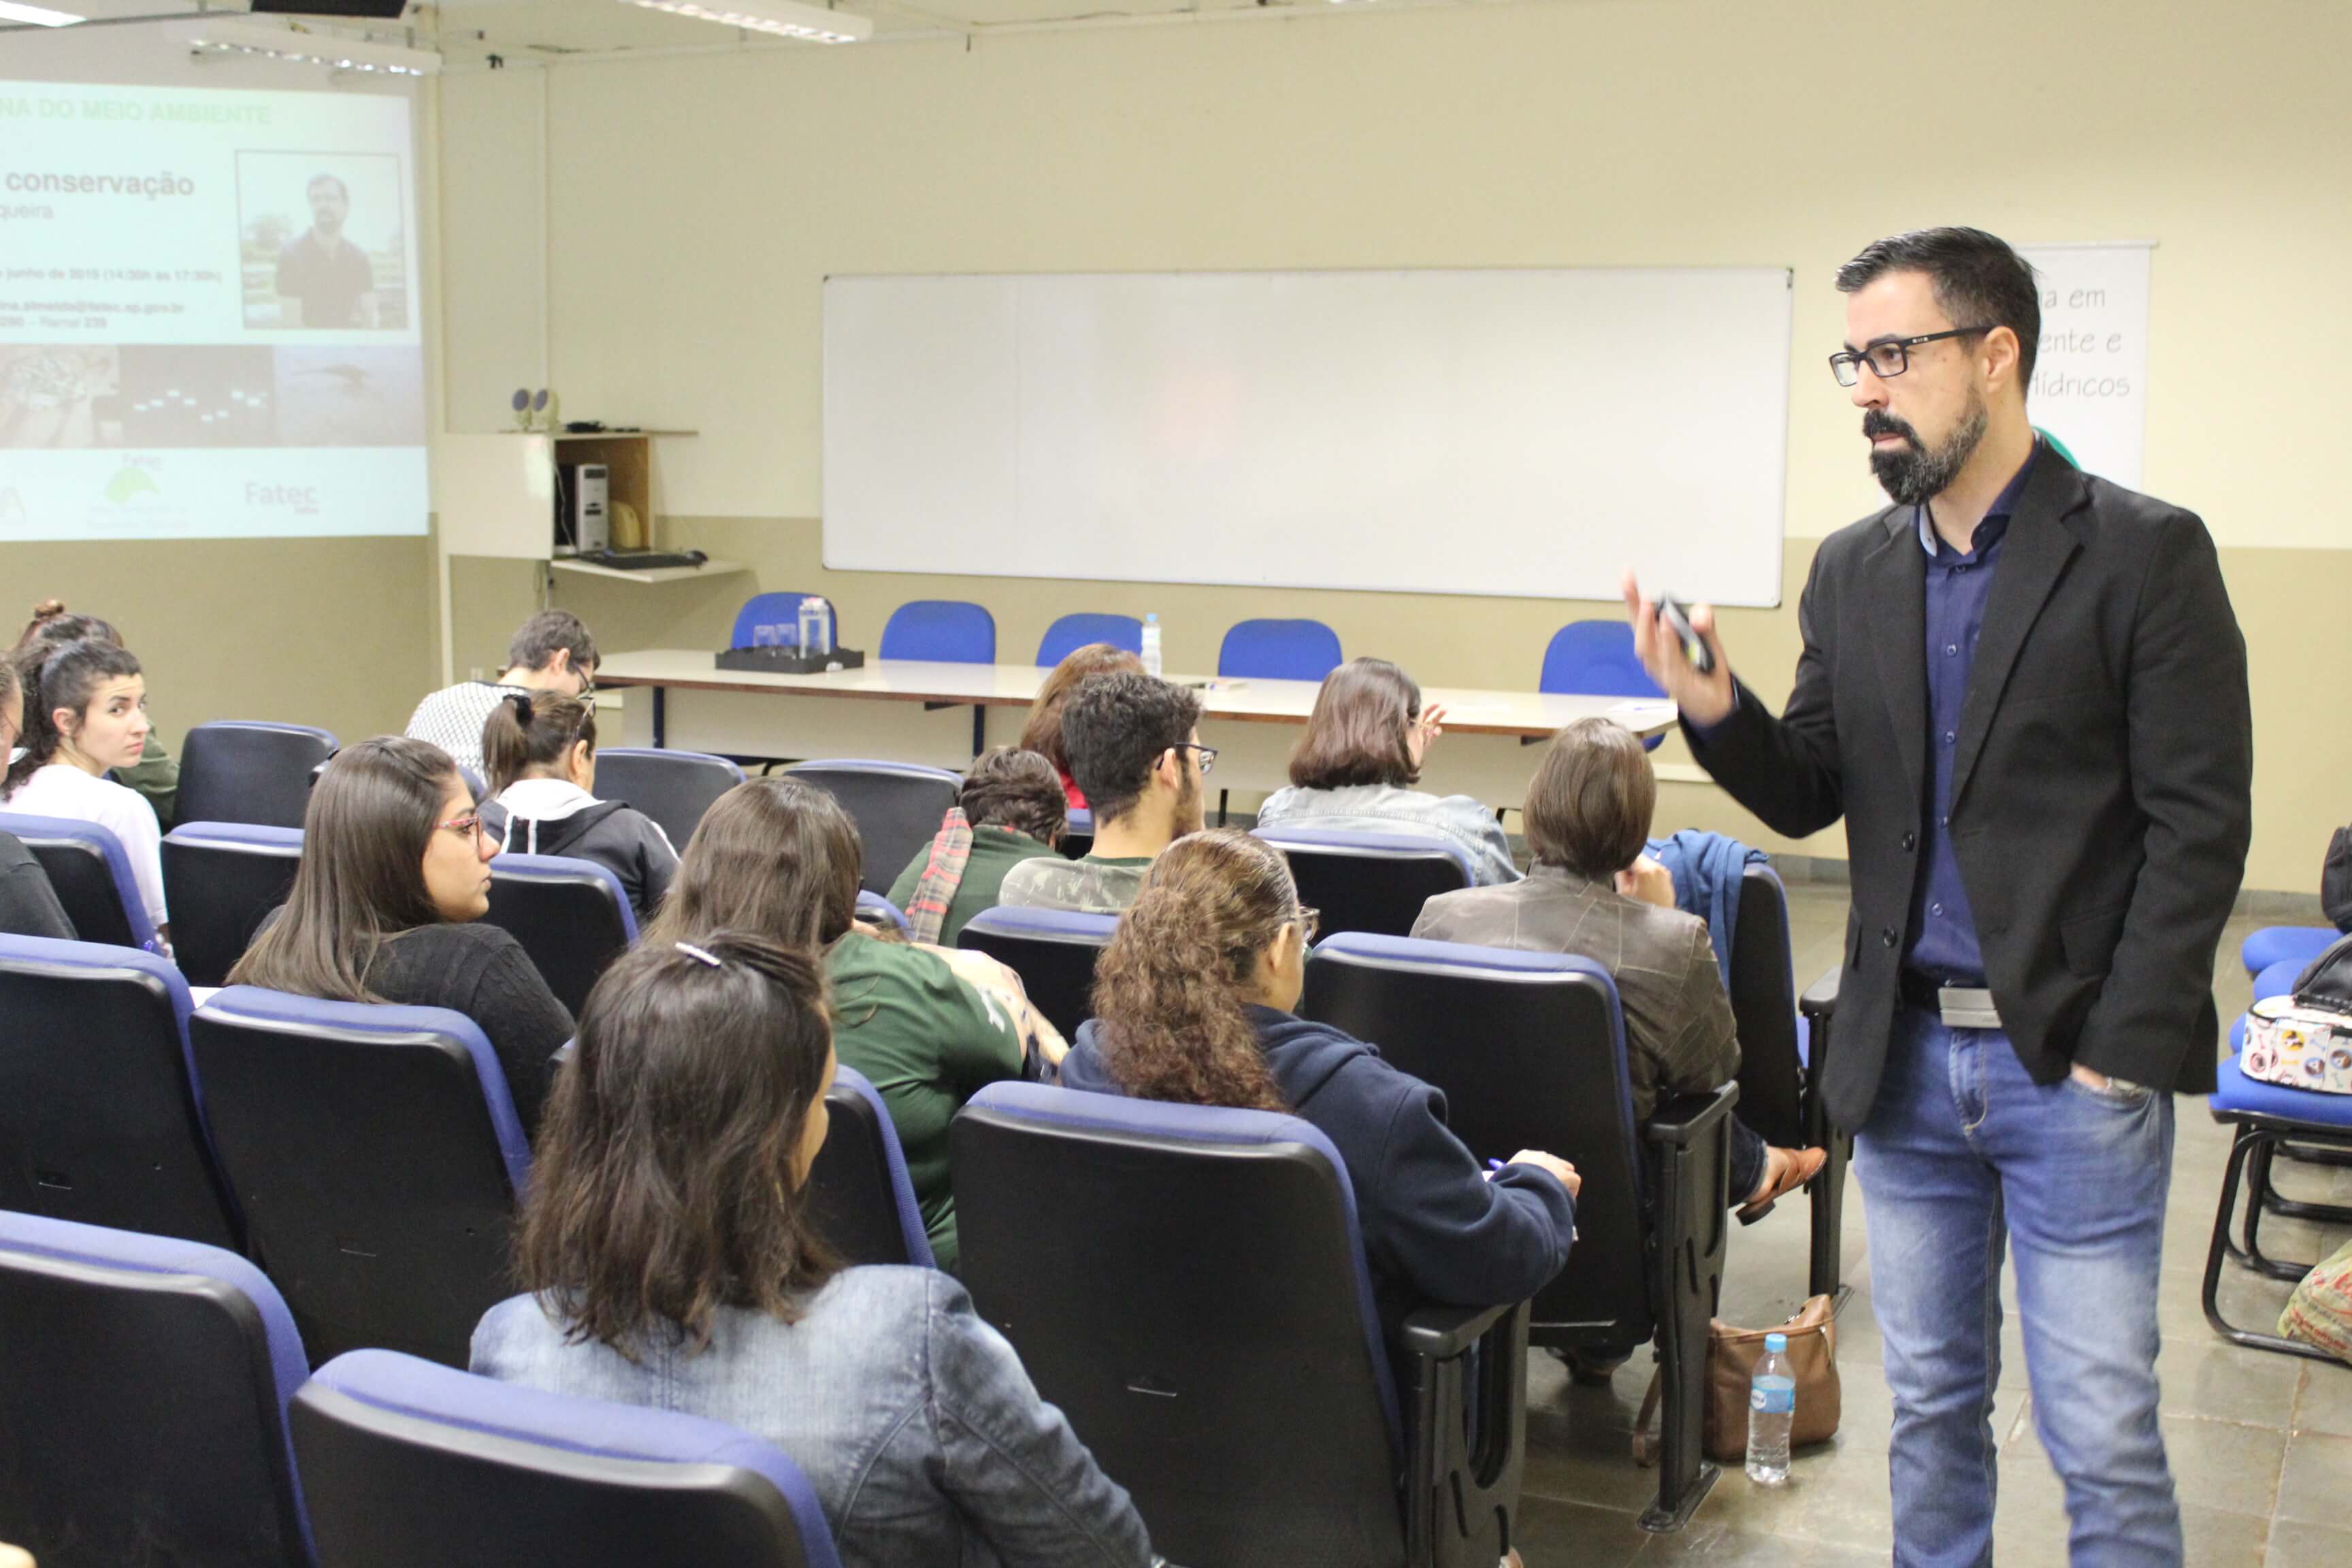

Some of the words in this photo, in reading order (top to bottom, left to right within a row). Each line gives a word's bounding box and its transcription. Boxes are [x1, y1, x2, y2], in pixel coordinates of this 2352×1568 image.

[38, 98, 75, 119] DO
[81, 98, 142, 121] MEIO
[149, 102, 272, 125] AMBIENTE
[6, 170, 195, 201] conservação
[2069, 289, 2106, 310] em
[2106, 333, 2122, 354] e
[244, 480, 318, 506] Fatec
